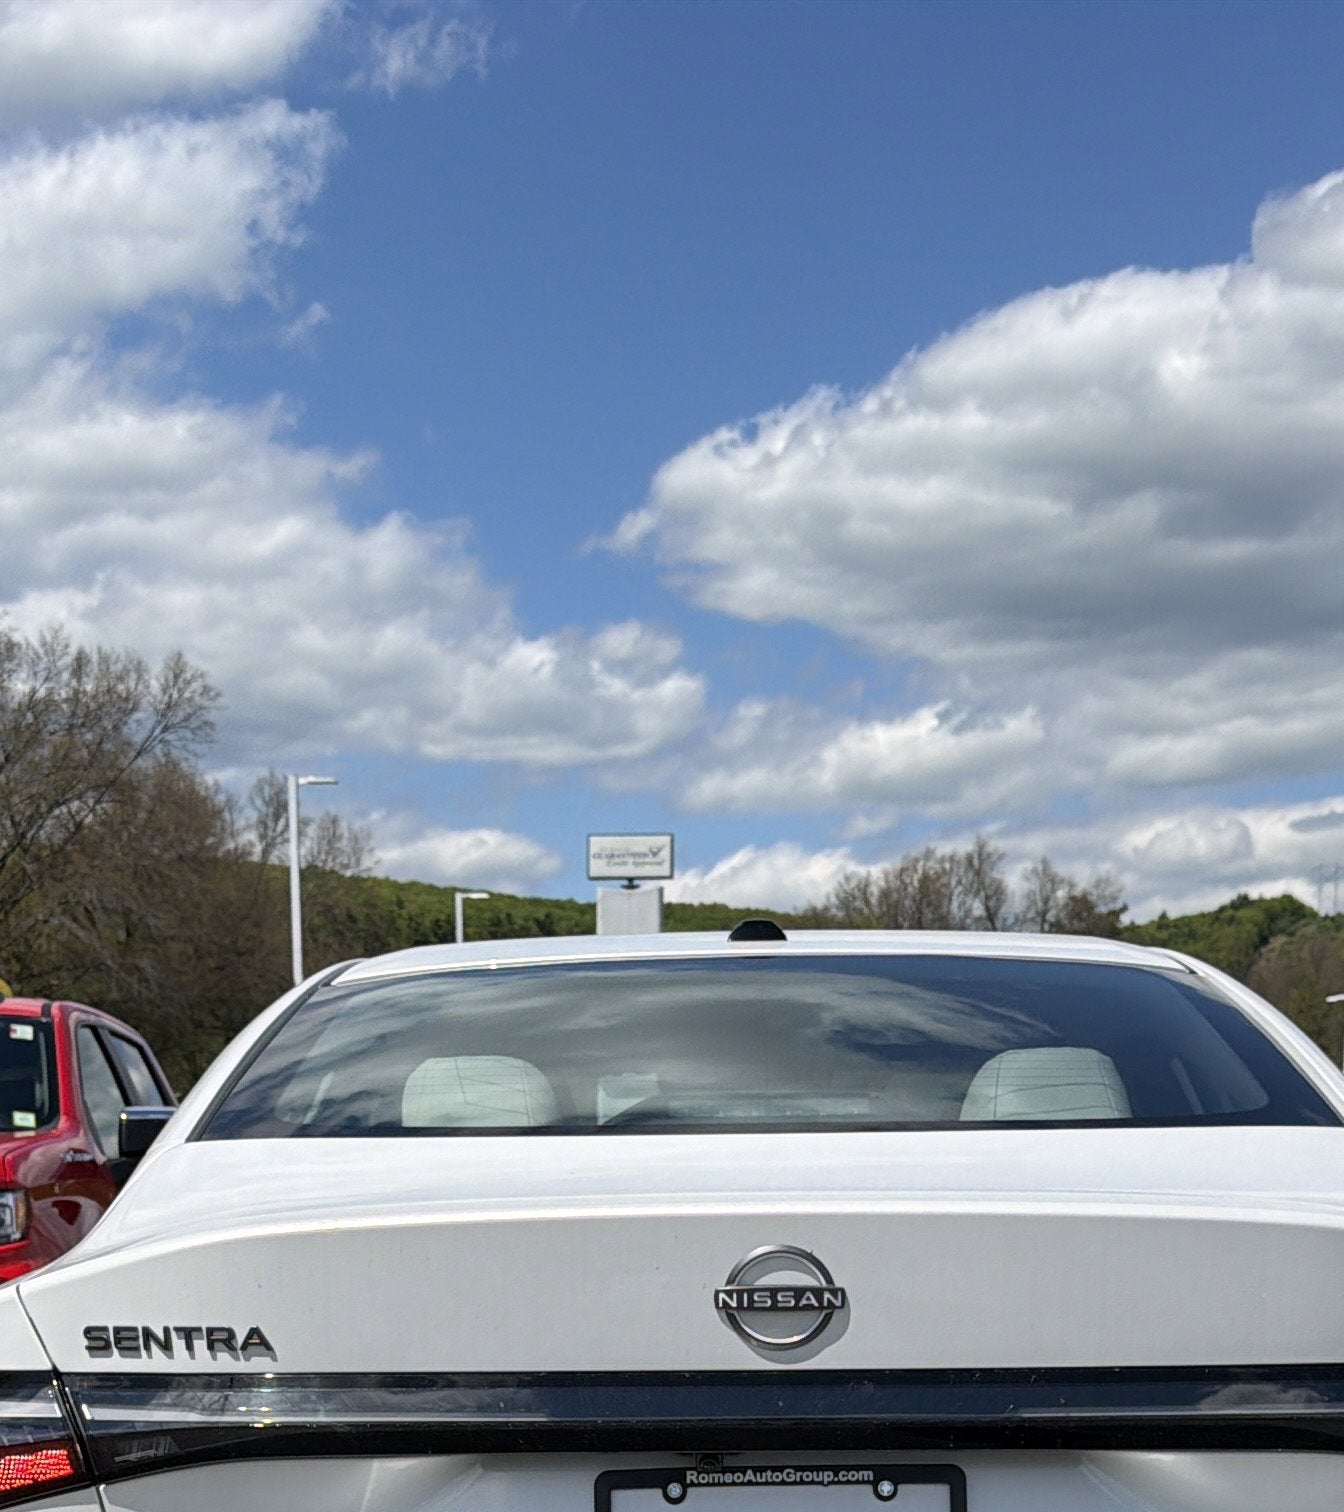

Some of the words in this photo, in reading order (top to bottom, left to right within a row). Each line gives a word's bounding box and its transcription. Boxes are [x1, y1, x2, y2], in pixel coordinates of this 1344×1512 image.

[718, 1290, 843, 1308] NISSAN
[83, 1325, 276, 1351] SENTRA
[685, 1468, 874, 1485] RomeoAutoGroup.com
